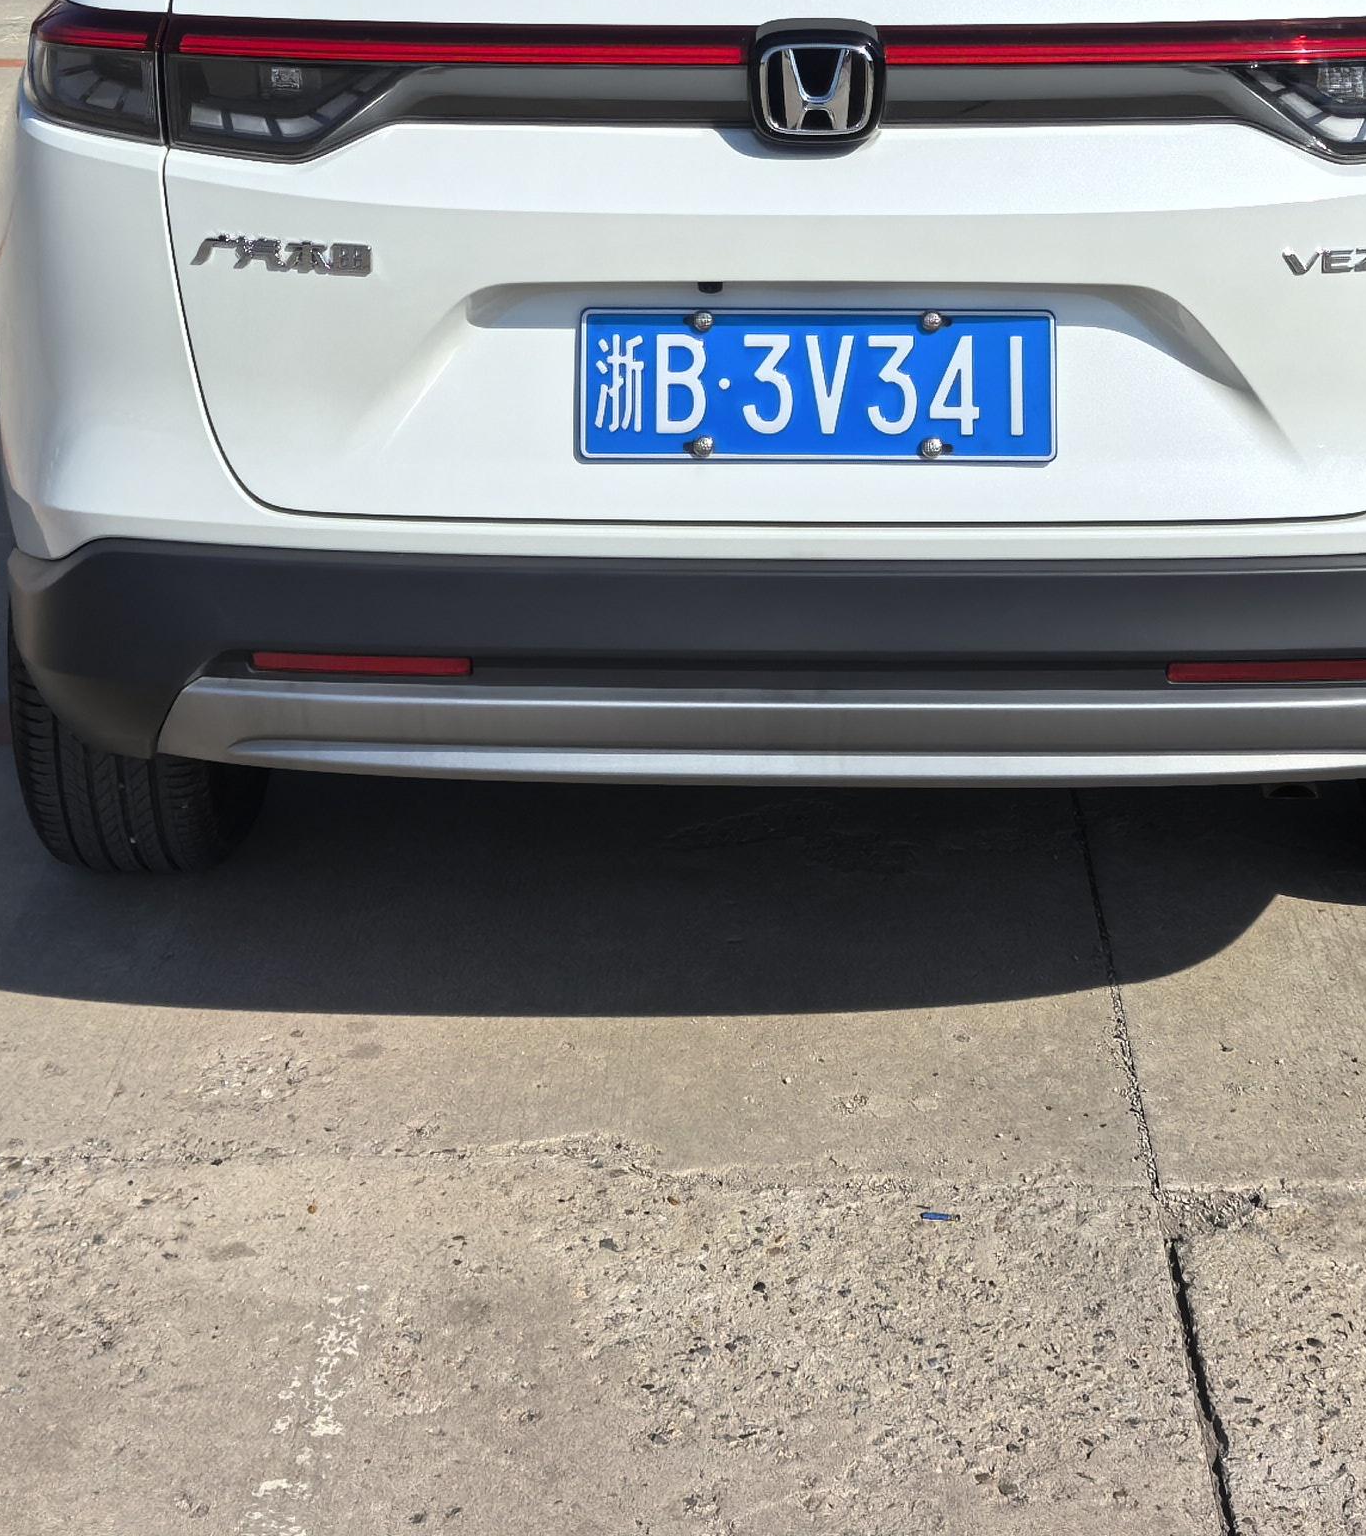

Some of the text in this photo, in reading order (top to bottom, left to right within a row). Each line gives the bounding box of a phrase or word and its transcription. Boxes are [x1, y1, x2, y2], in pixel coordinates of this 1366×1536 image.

[190, 235, 372, 276] 广汽本田
[595, 333, 1023, 435] 浙B·3V341
